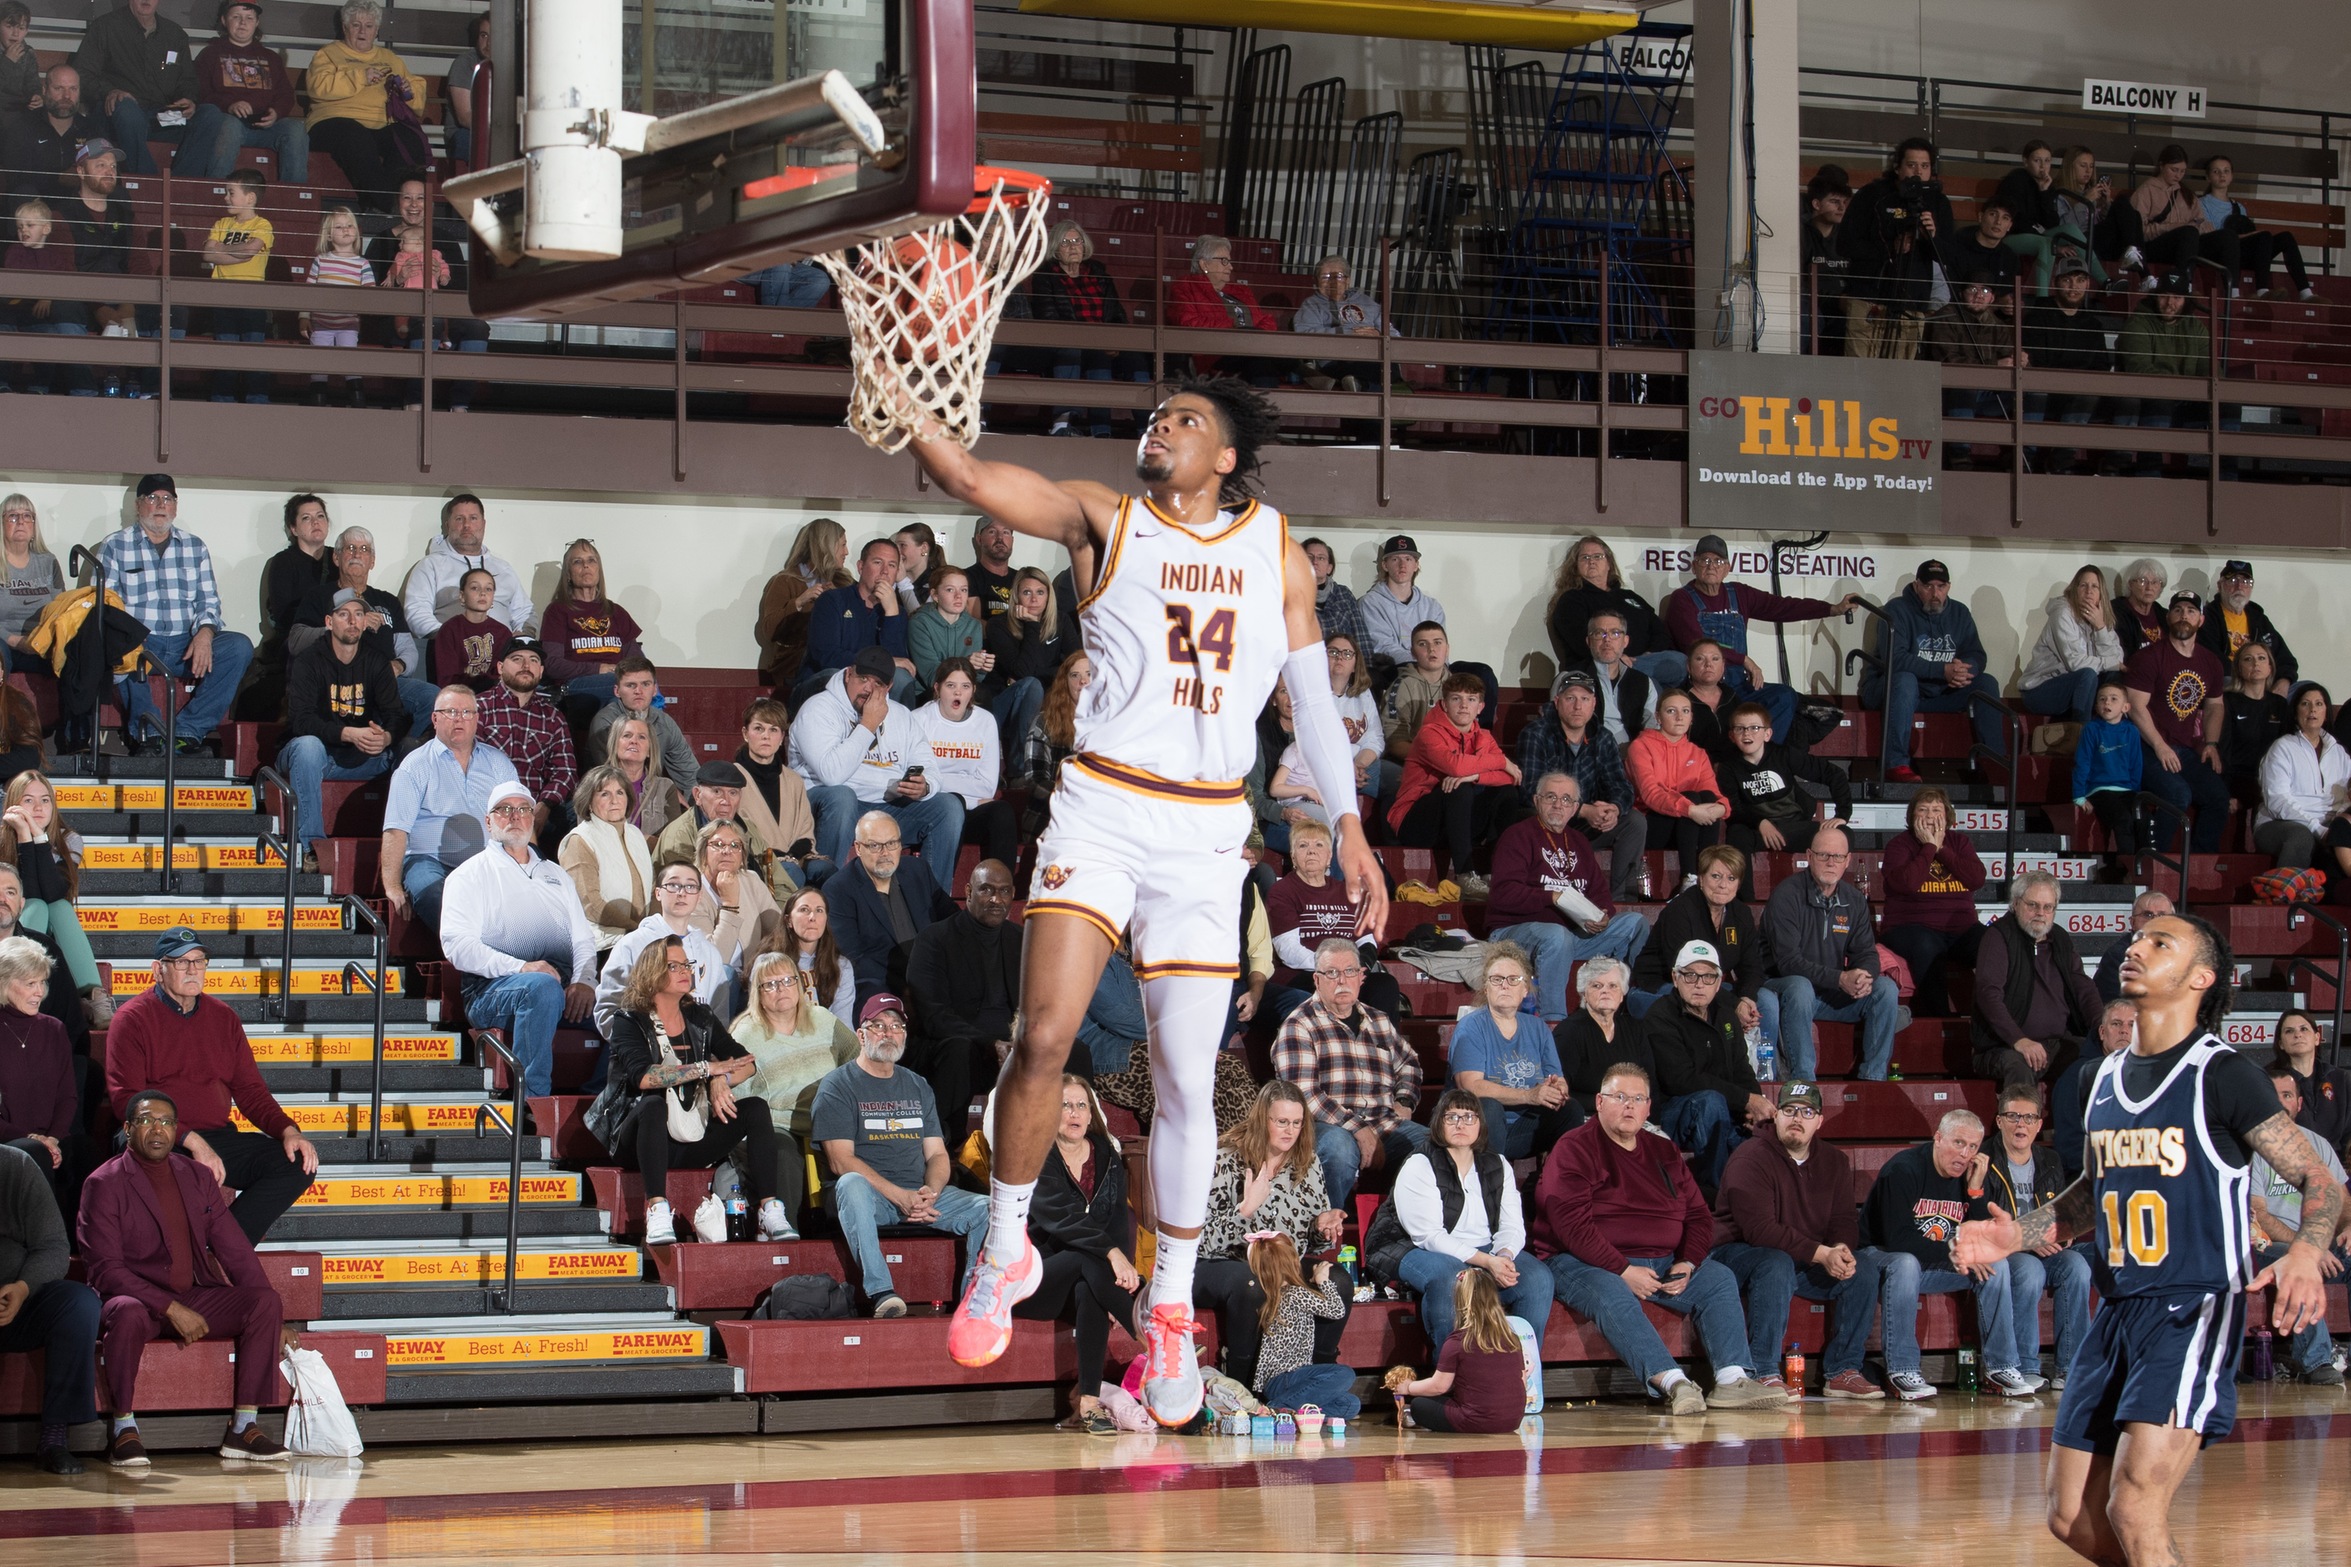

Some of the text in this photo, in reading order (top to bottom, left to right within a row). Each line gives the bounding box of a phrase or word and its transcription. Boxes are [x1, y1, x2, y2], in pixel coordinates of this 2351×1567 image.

[2091, 85, 2200, 111] BALCONY H
[1700, 396, 1932, 460] GO Hills TV
[1700, 468, 1933, 493] Download the App Today!
[1645, 550, 1876, 578] RESVED SEATING
[1161, 562, 1243, 597] INDIAN
[571, 637, 602, 649] INDIAN
[1165, 602, 1238, 674] 24
[1752, 771, 1769, 781] THE
[1743, 779, 1770, 790] NORTH
[1751, 785, 1772, 796] FACE
[55, 789, 157, 802] Best At Fresh!
[177, 789, 247, 801] FAREWAY
[94, 850, 198, 863] Best At Fesh!
[1991, 860, 2086, 879] 64-5151
[77, 910, 118, 922] EWAY
[139, 912, 245, 925] Best At Fresh!
[267, 909, 339, 921] FAEWAY
[202, 975, 223, 988] est
[230, 975, 247, 988] At
[251, 1041, 351, 1055] est At Fresh!
[383, 1039, 448, 1051] AREWAY
[858, 1100, 922, 1112] INDIAN HILLS
[293, 1110, 325, 1123] Best
[868, 1132, 920, 1141] BASKETBALL
[2089, 1126, 2187, 1178] TIGERS
[351, 1183, 466, 1198] Best At Fresh!
[489, 1180, 567, 1193] FAEWAY
[2102, 1190, 2169, 1267] 10
[323, 1259, 384, 1272] REWAY
[407, 1261, 442, 1274] Best
[451, 1260, 468, 1273] At
[549, 1255, 627, 1268] FAREWAY
[469, 1338, 588, 1355] Best At Fresh!
[613, 1334, 693, 1348] FAREWAY
[386, 1341, 445, 1355] REWAY
